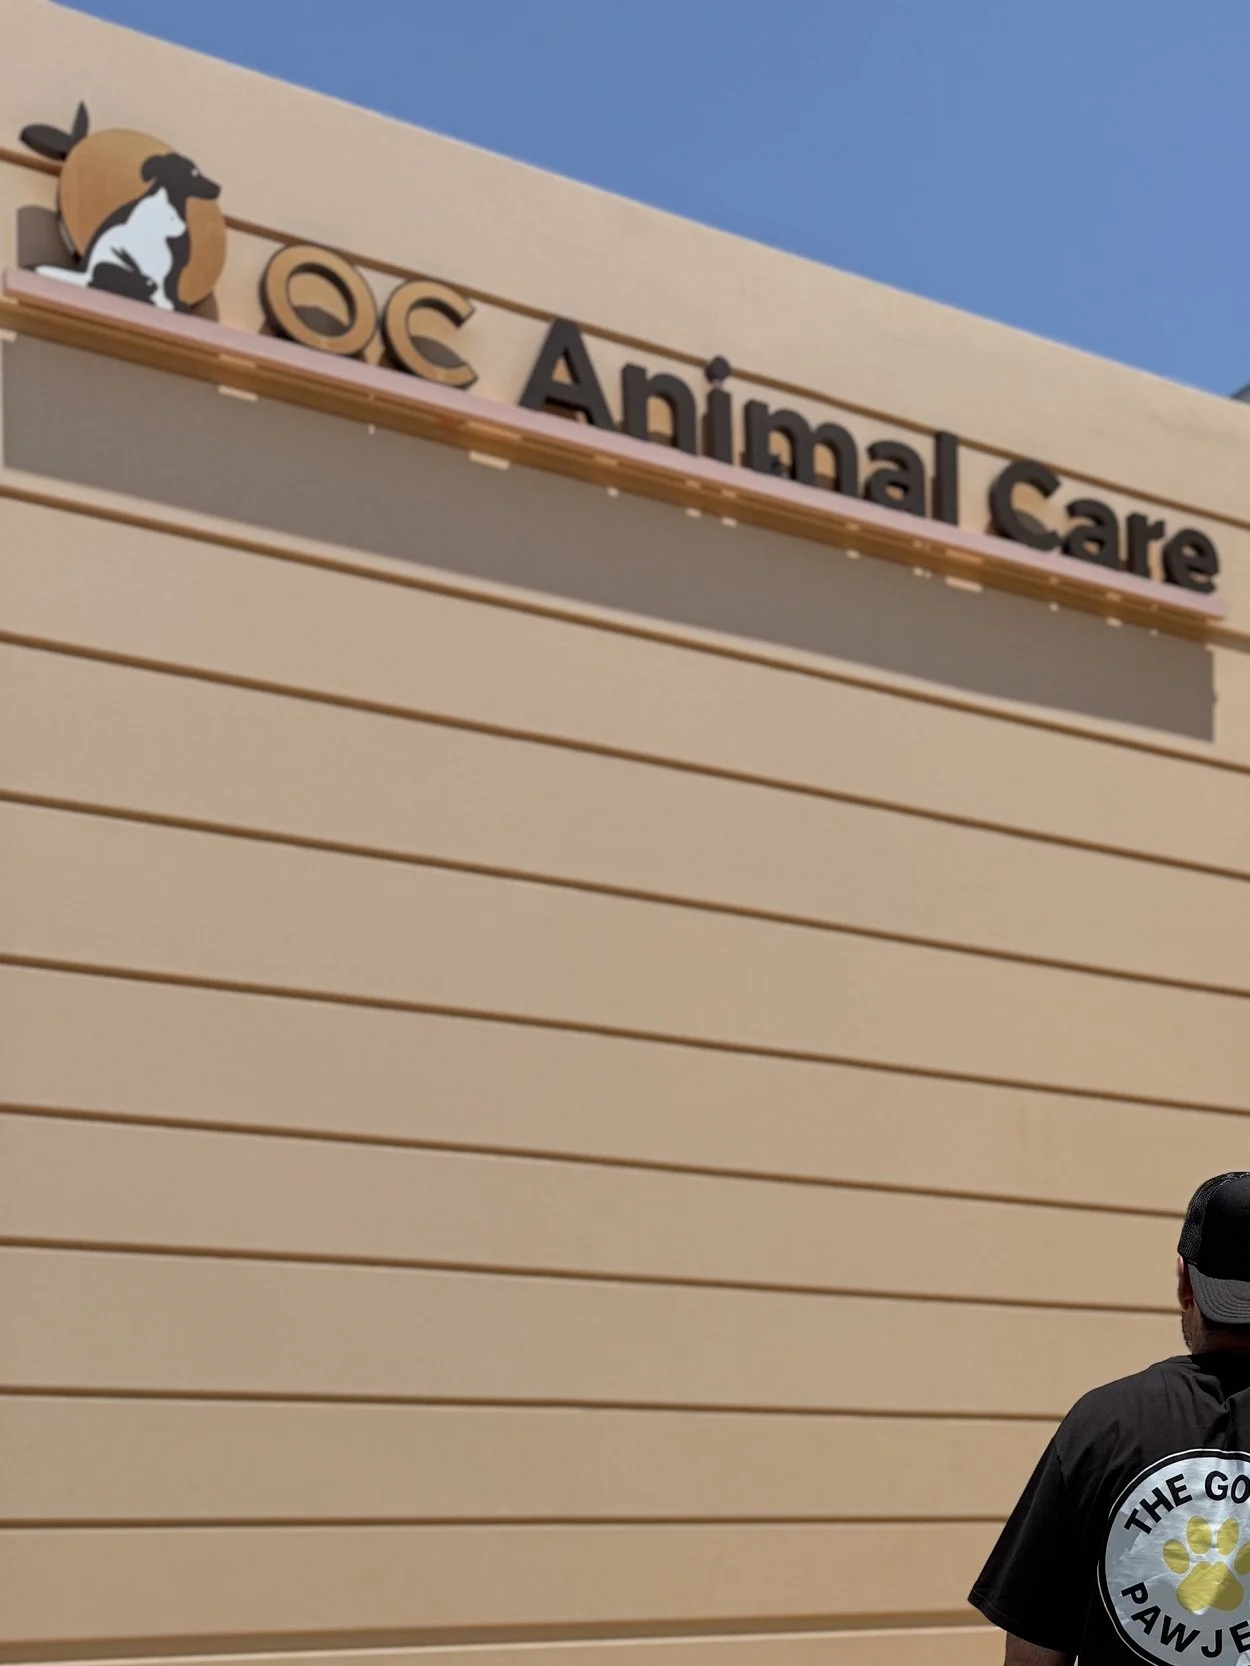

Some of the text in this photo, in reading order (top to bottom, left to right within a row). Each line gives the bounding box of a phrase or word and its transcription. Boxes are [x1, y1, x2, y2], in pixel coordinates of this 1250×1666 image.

[259, 243, 1220, 595] OC Animal Care
[1123, 1472, 1193, 1535] THE
